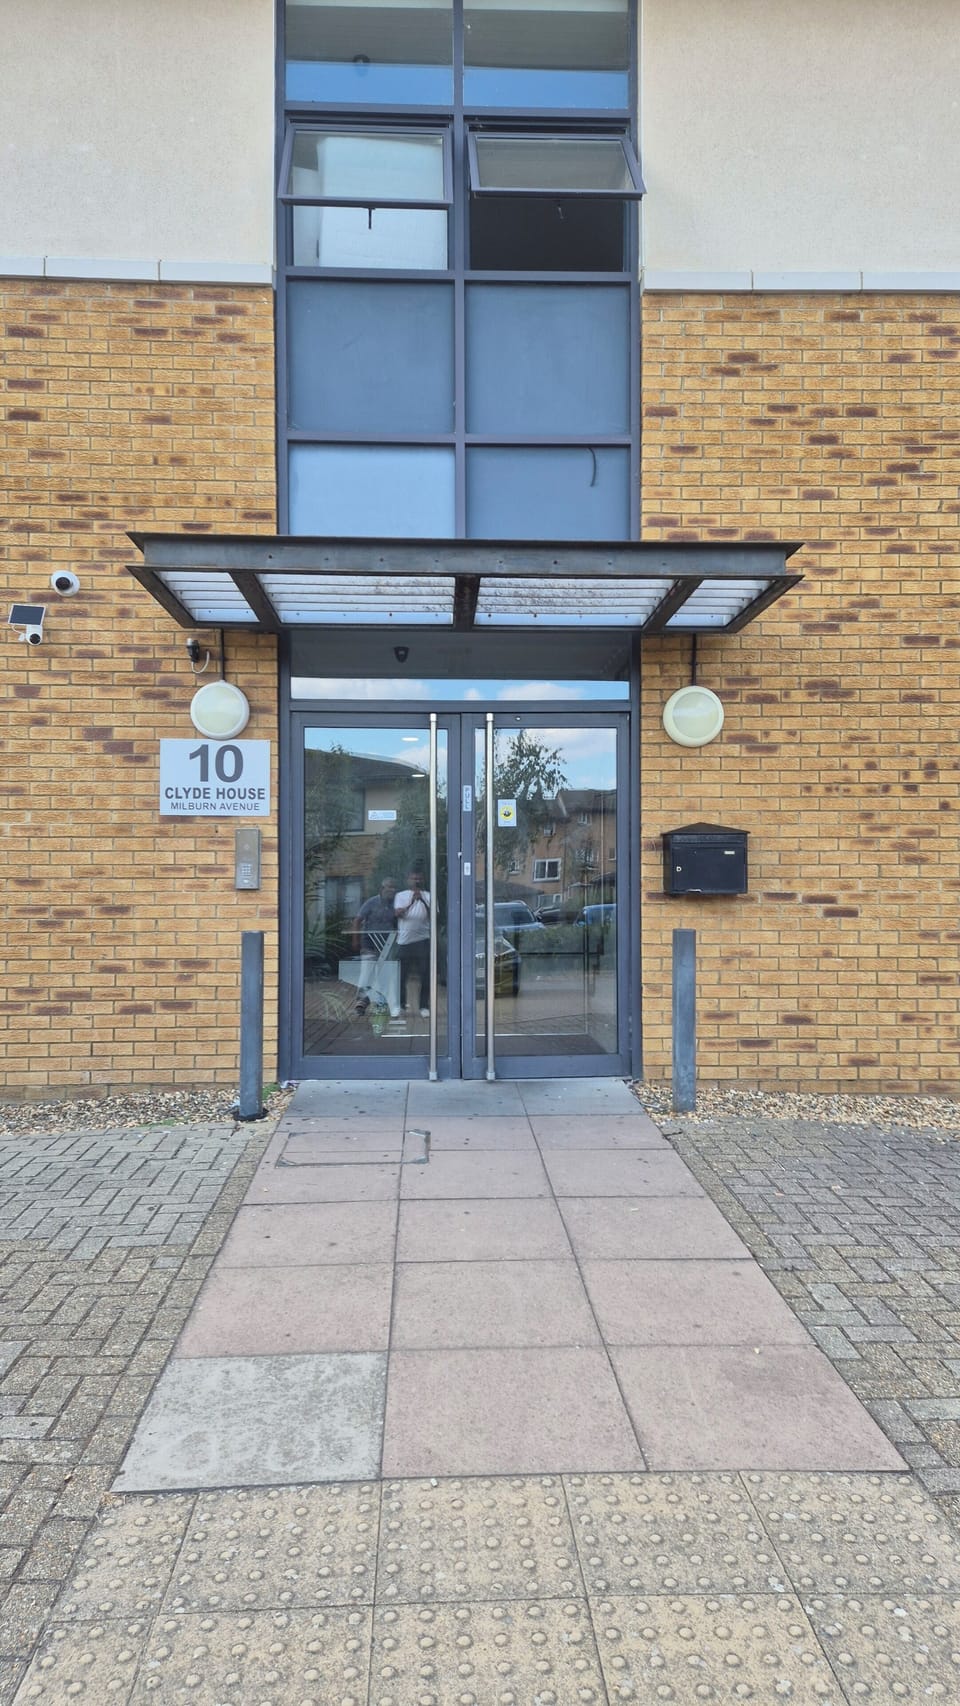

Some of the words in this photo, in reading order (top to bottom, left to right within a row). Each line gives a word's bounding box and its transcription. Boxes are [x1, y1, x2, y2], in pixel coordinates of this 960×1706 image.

[189, 744, 244, 783] 10
[165, 787, 211, 800] CLYDE
[216, 787, 265, 800] HOUSE
[170, 802, 217, 811] MILBURN
[219, 803, 260, 811] AVENUE
